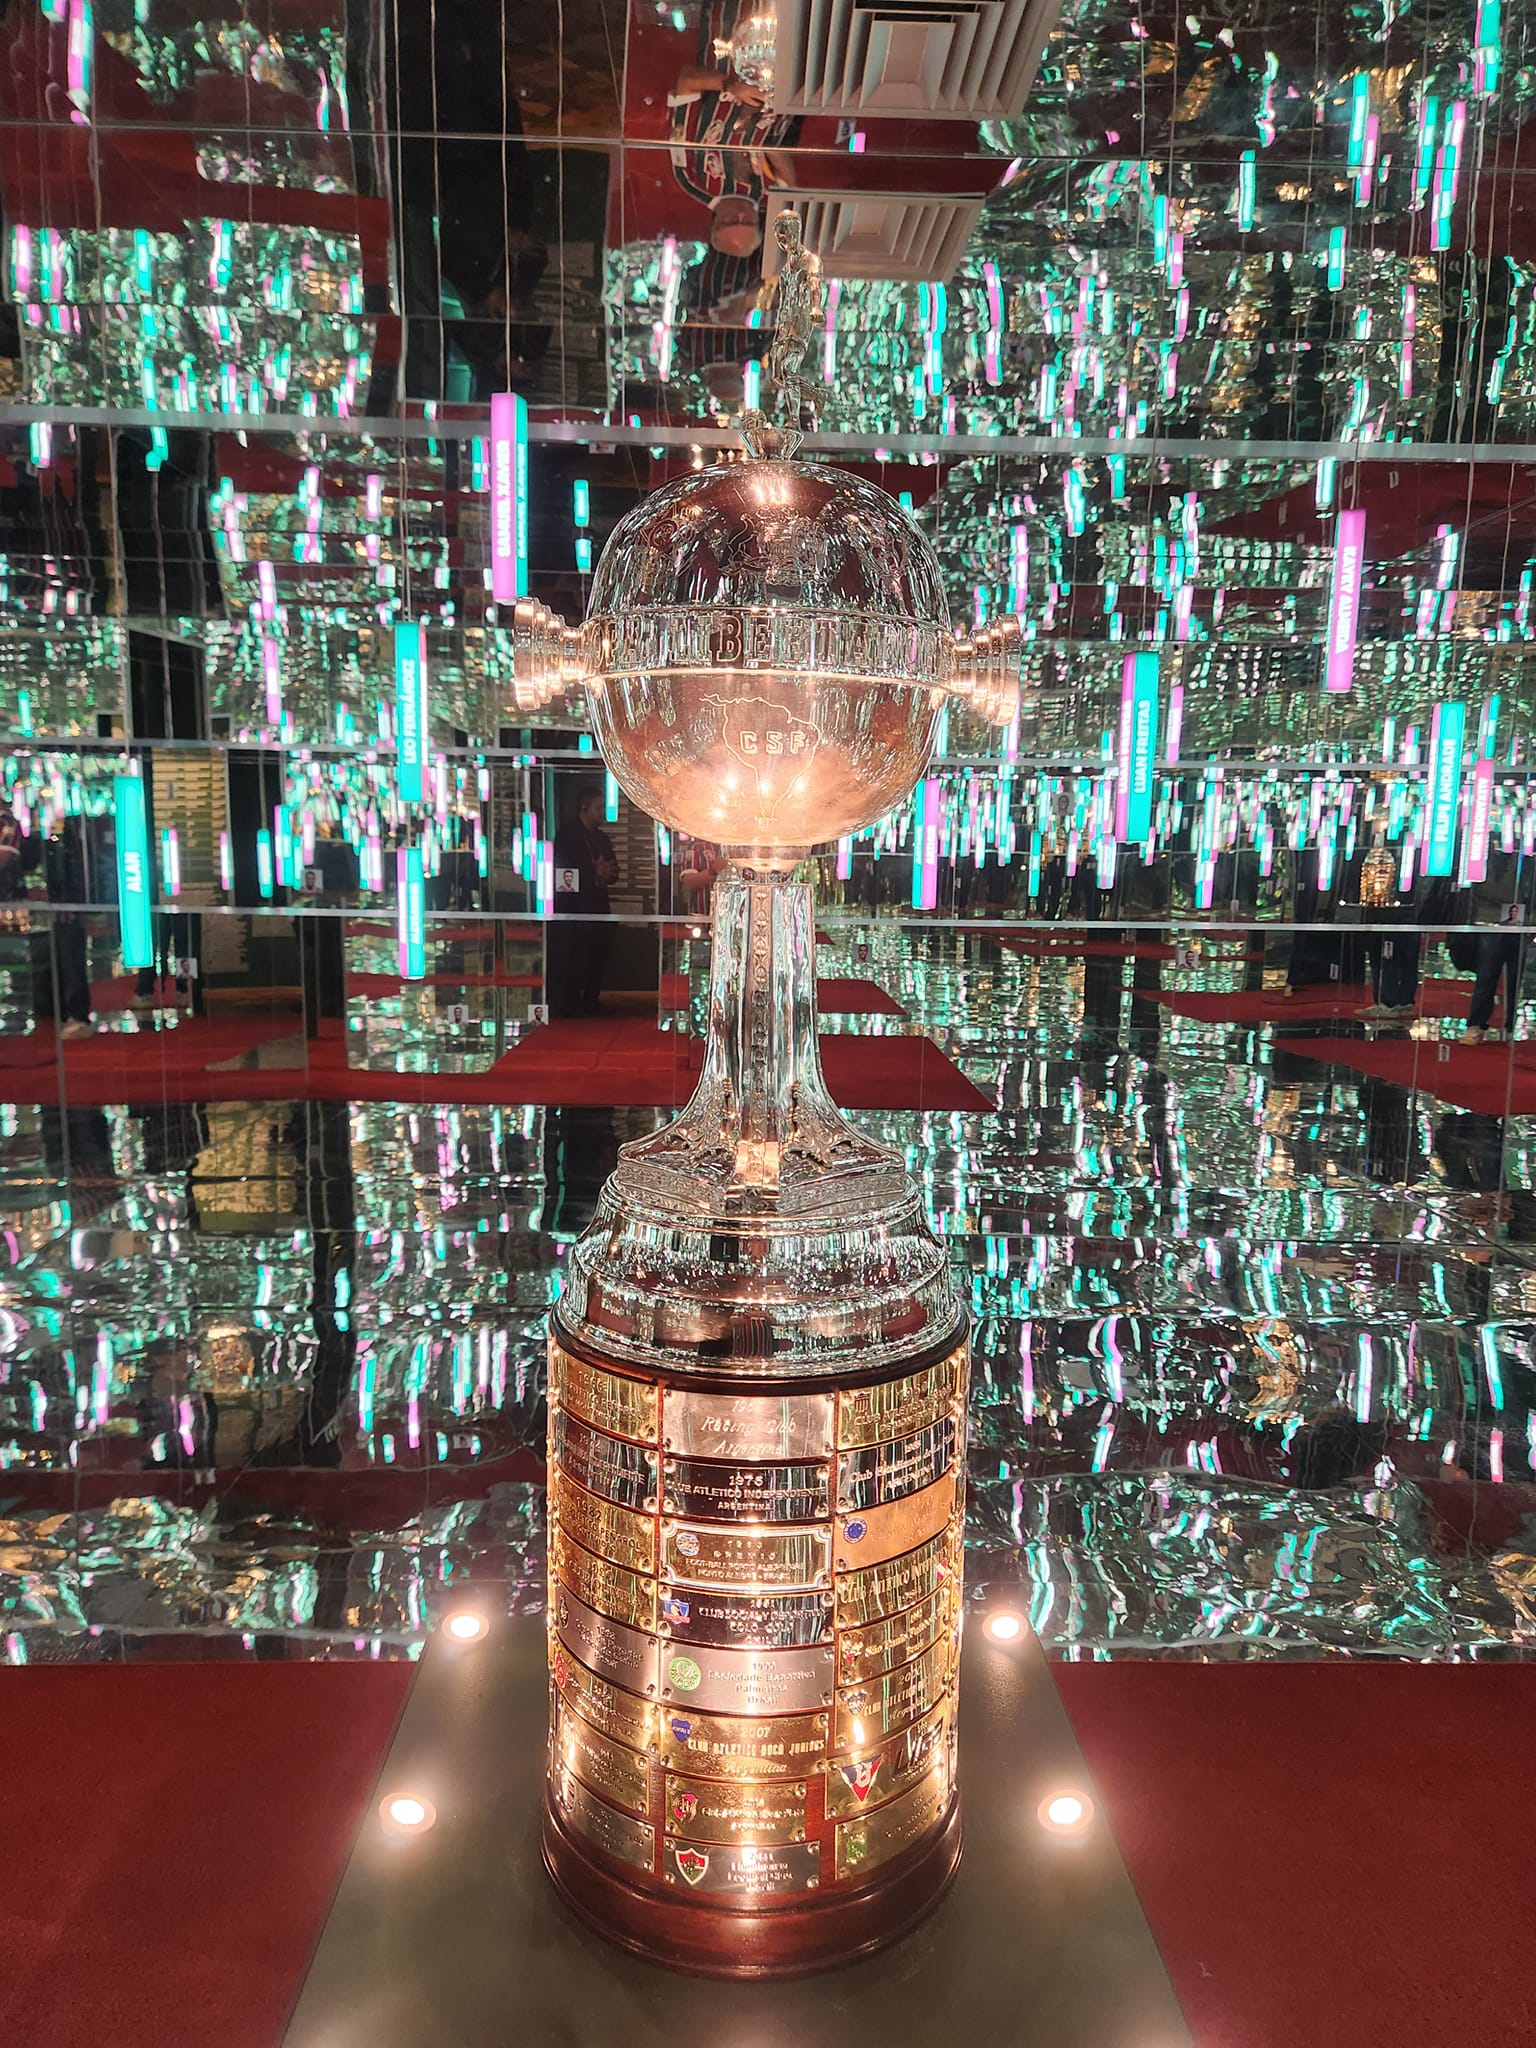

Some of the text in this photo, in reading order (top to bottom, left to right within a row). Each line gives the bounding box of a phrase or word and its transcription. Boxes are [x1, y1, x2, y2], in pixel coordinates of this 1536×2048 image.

[497, 440, 510, 557] SAMUEL XAVIER
[1335, 546, 1357, 654] KAYKY ALMEIDA
[401, 658, 417, 764] LEO FERNÁNDEZ
[1134, 699, 1150, 793] LUAN FREITAS
[1435, 739, 1456, 842] FELIPE ANDRADE
[124, 851, 142, 893] ALAN
[693, 1486, 742, 1499] ATLETICO
[849, 1470, 873, 1483] Club
[741, 1727, 771, 1738] 2007
